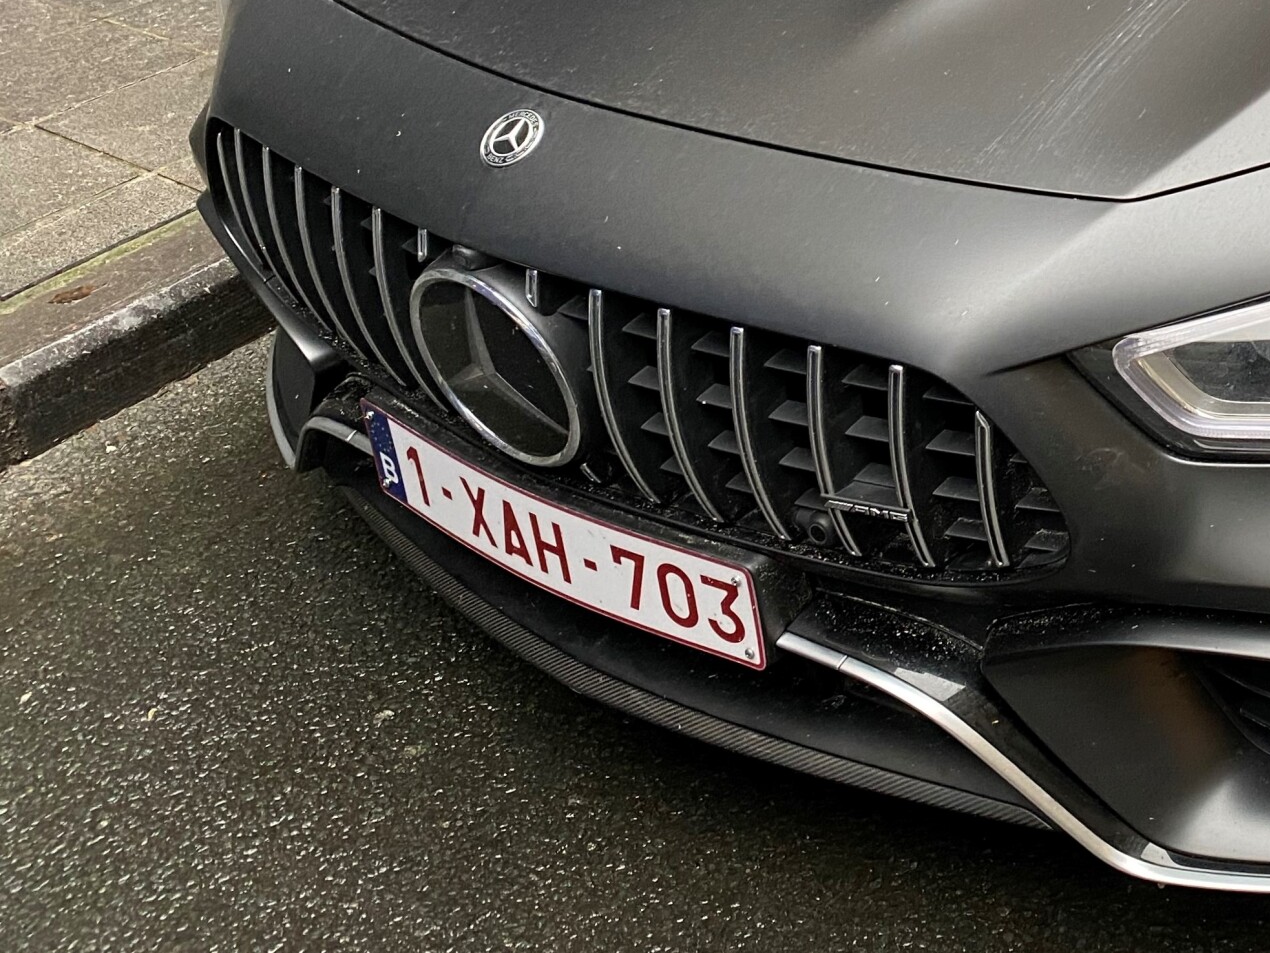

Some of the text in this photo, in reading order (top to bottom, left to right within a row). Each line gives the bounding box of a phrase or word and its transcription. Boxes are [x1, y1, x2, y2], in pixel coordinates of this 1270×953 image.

[487, 153, 505, 164] BENZ
[379, 452, 398, 484] B
[850, 505, 908, 523] AMG
[407, 446, 745, 643] 1-XAH-703
